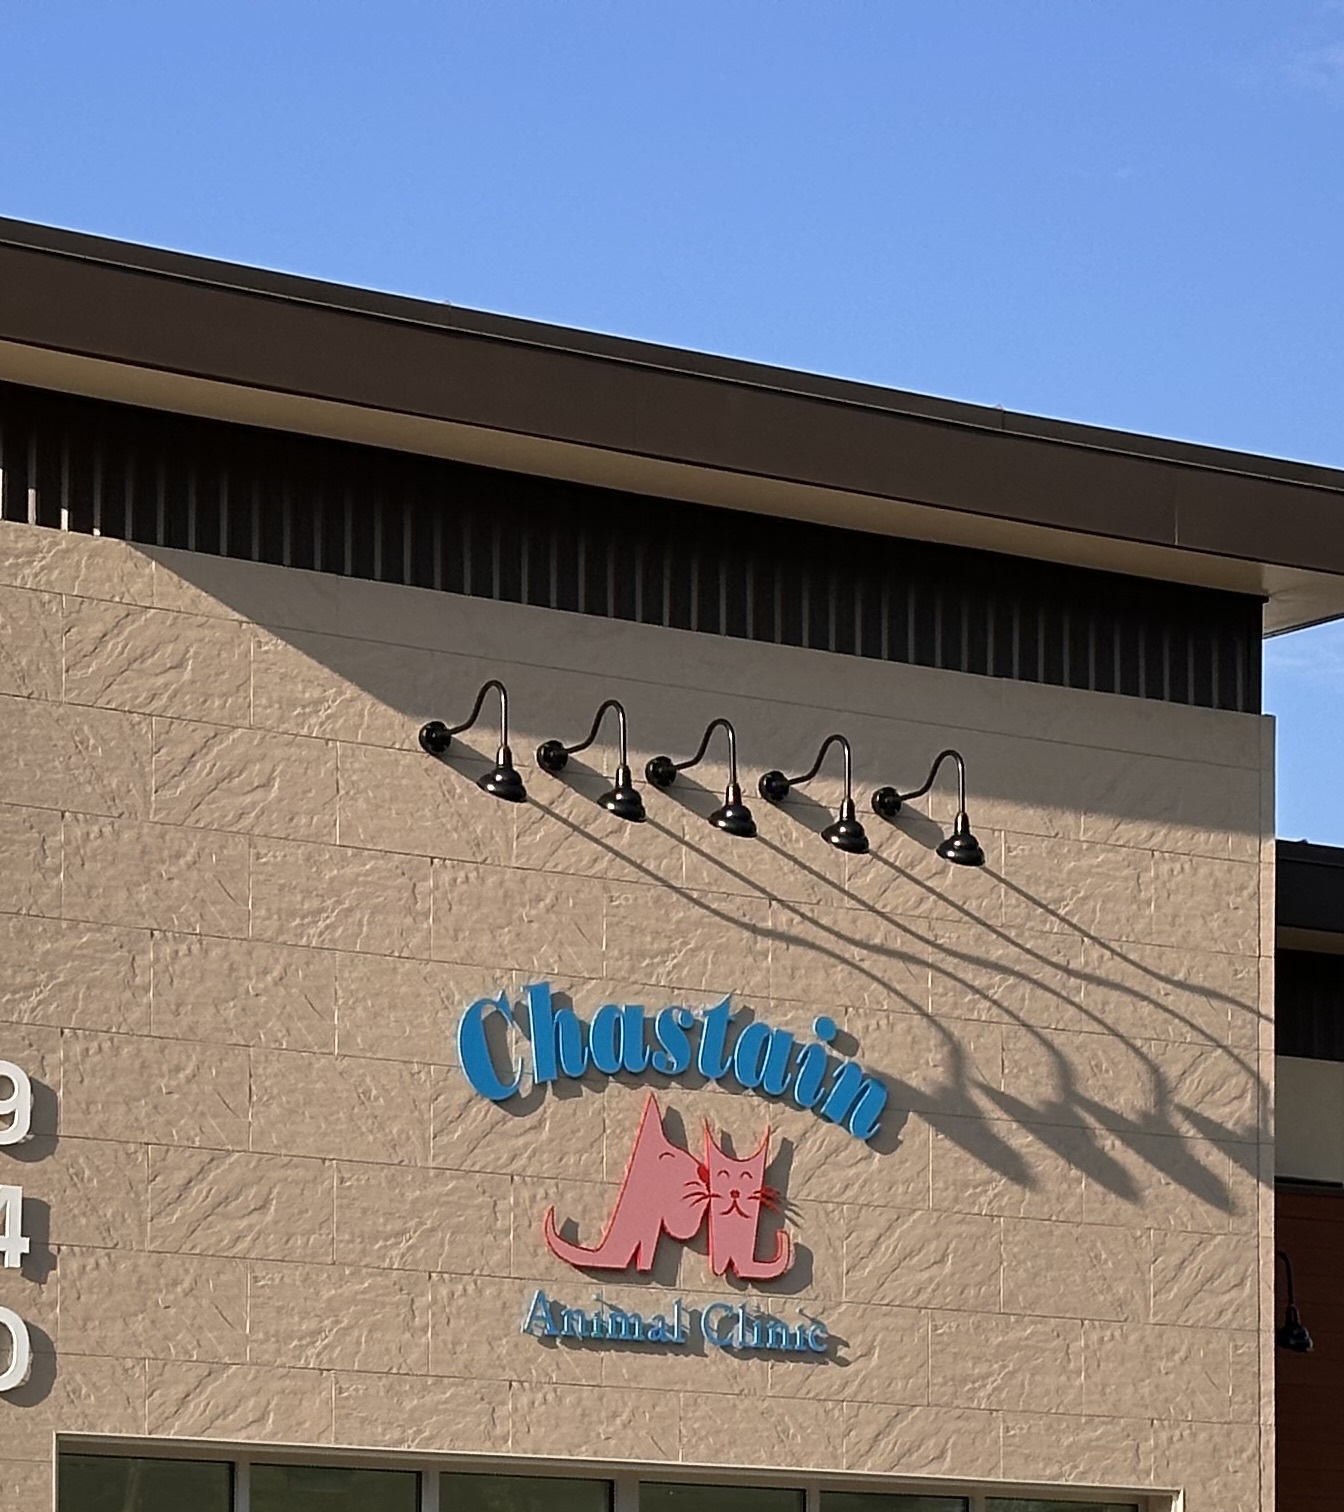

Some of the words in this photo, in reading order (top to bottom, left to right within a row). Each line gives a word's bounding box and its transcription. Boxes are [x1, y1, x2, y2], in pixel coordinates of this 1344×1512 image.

[457, 980, 888, 1141] Chastain
[521, 1289, 686, 1345] Animal
[701, 1301, 829, 1354] Clinic
